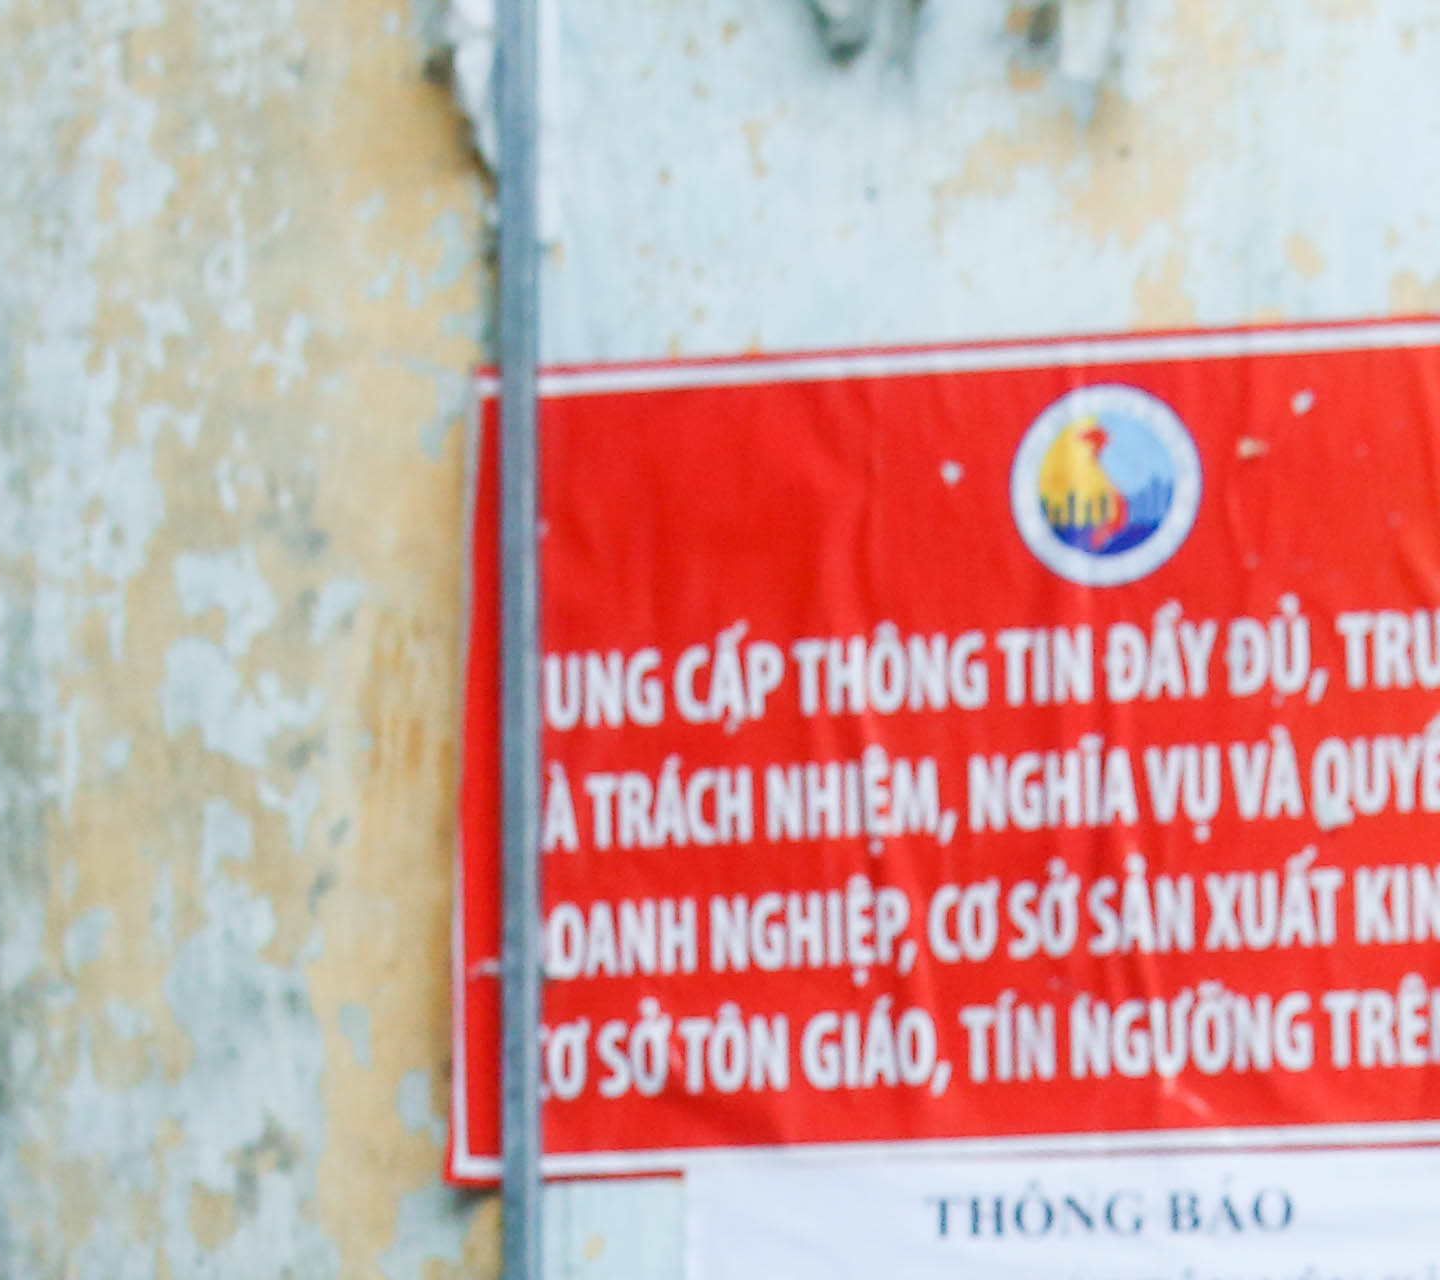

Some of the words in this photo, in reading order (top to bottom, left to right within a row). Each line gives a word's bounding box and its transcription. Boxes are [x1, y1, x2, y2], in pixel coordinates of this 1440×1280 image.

[543, 647, 664, 731] UNG
[792, 620, 989, 718] THÔNG
[996, 622, 1093, 707] TIN
[1225, 593, 1329, 705] ĐỦ,
[541, 758, 580, 854] À
[585, 753, 753, 852] TRÁCH
[764, 743, 957, 858] NHIỆM,
[967, 732, 1138, 834] NGHĨA
[1143, 743, 1221, 844] VỤ
[1229, 723, 1304, 821] VÀ
[541, 896, 698, 981] OANH
[709, 873, 918, 987] NGHIỆP,
[926, 877, 1000, 964] CƠ
[1008, 857, 1081, 960] SỞ
[1088, 852, 1195, 956] SẢN
[1204, 845, 1344, 953] XUẤT
[595, 996, 672, 1099] SỞ
[678, 1001, 790, 1096] TÔN
[800, 994, 953, 1098] GIÁO,
[962, 988, 1058, 1083] TÍN
[1069, 979, 1315, 1080] NGƯỠNG
[923, 1178, 1145, 1239] THÔNG
[1168, 1173, 1296, 1236] BÁO
